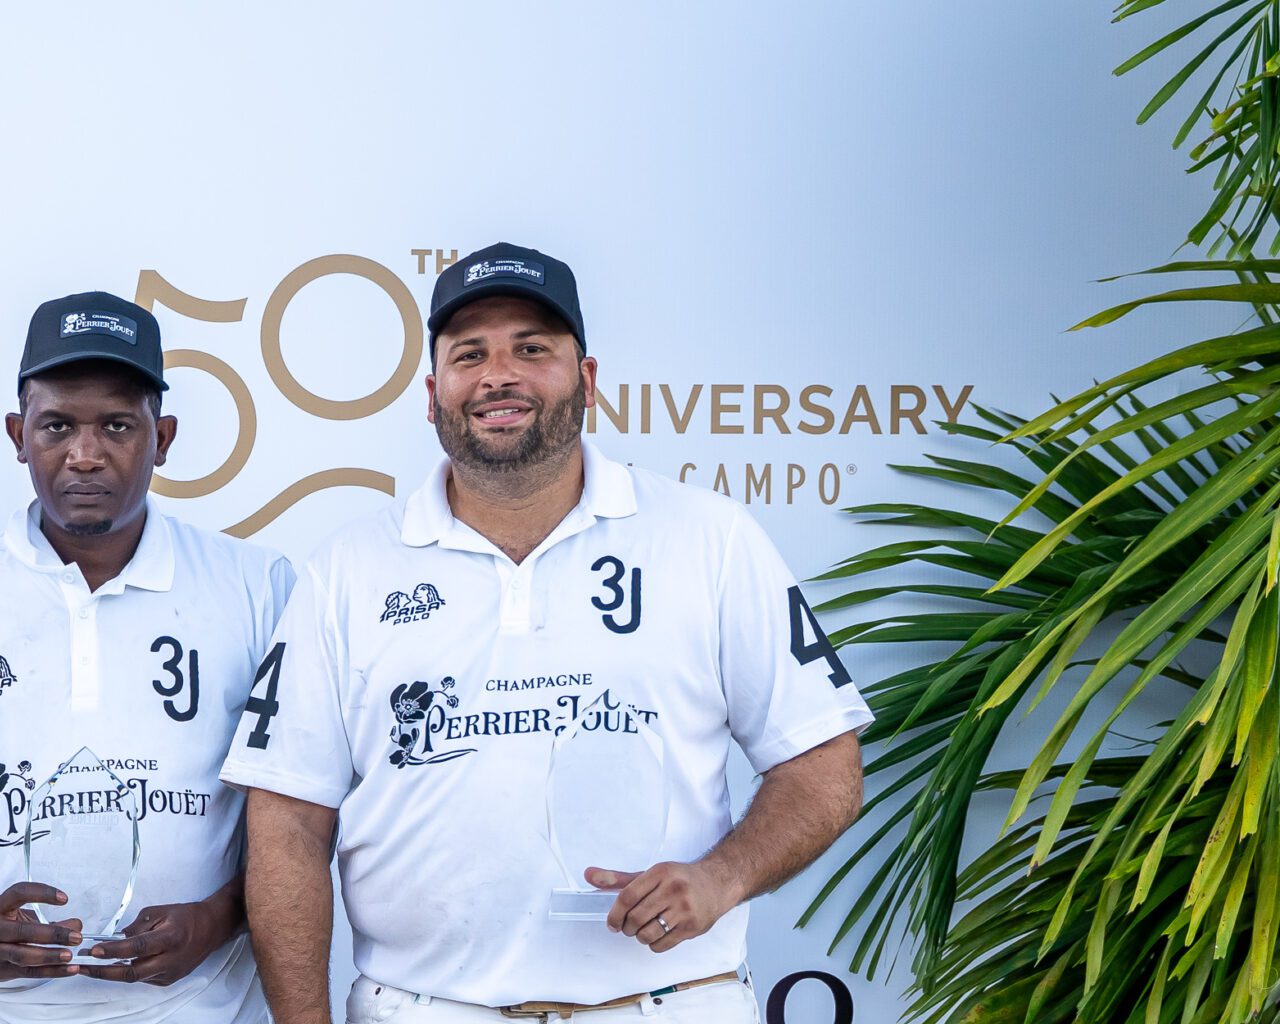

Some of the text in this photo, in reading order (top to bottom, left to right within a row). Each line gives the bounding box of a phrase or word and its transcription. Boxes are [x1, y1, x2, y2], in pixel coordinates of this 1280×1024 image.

[586, 383, 975, 435] NIVERSARY
[385, 601, 440, 622] PRISA
[393, 612, 430, 626] POLO
[787, 584, 854, 690] 4
[244, 641, 287, 751] 4
[485, 672, 594, 692] CHAMPAGNE
[2, 777, 212, 837] PRRIERJOUËT
